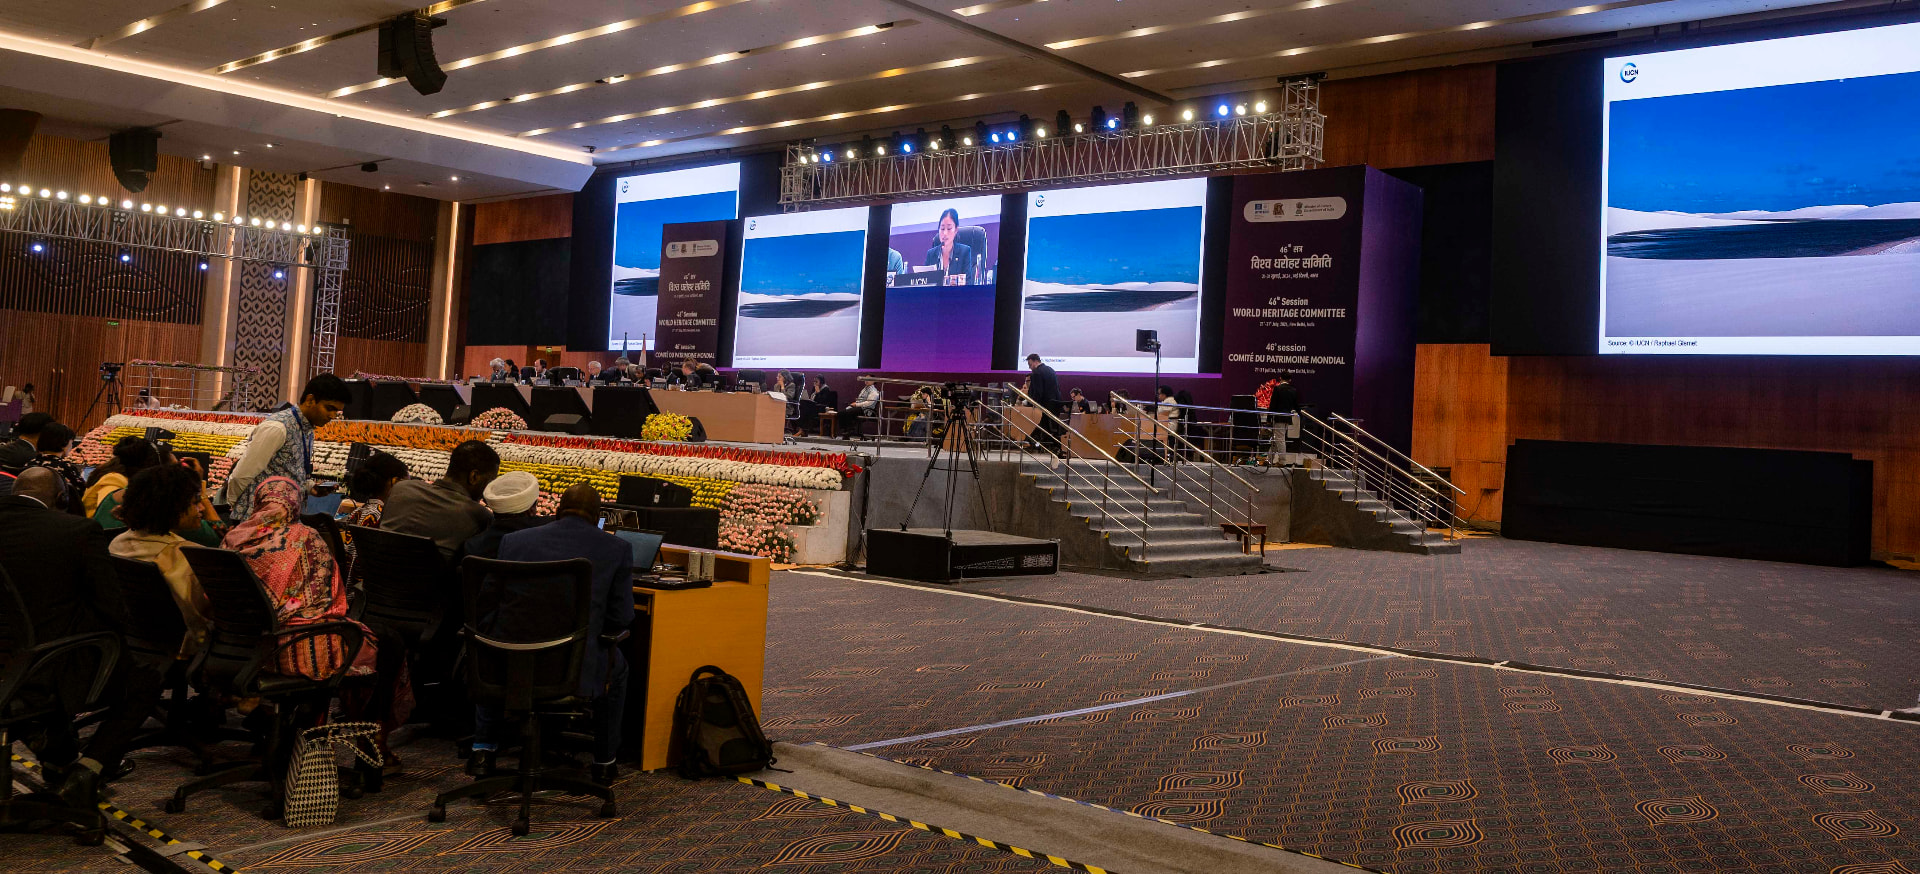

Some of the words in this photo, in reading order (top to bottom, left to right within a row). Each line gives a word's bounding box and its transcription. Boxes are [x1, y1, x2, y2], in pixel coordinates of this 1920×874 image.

[1251, 255, 1272, 270] विश्व
[1274, 255, 1300, 269] धरोहर
[1302, 254, 1332, 269] समिति
[1281, 297, 1308, 306] Session
[1233, 308, 1261, 318] WORLD
[1262, 308, 1299, 318] HERITAGE
[1300, 308, 1346, 318] COMMITTEE
[1278, 343, 1306, 352] session
[1228, 352, 1254, 363] COMITÉ
[1255, 355, 1265, 363] DU
[1266, 355, 1310, 364] PATRIMOINE
[1311, 356, 1345, 365] MONDIAL
